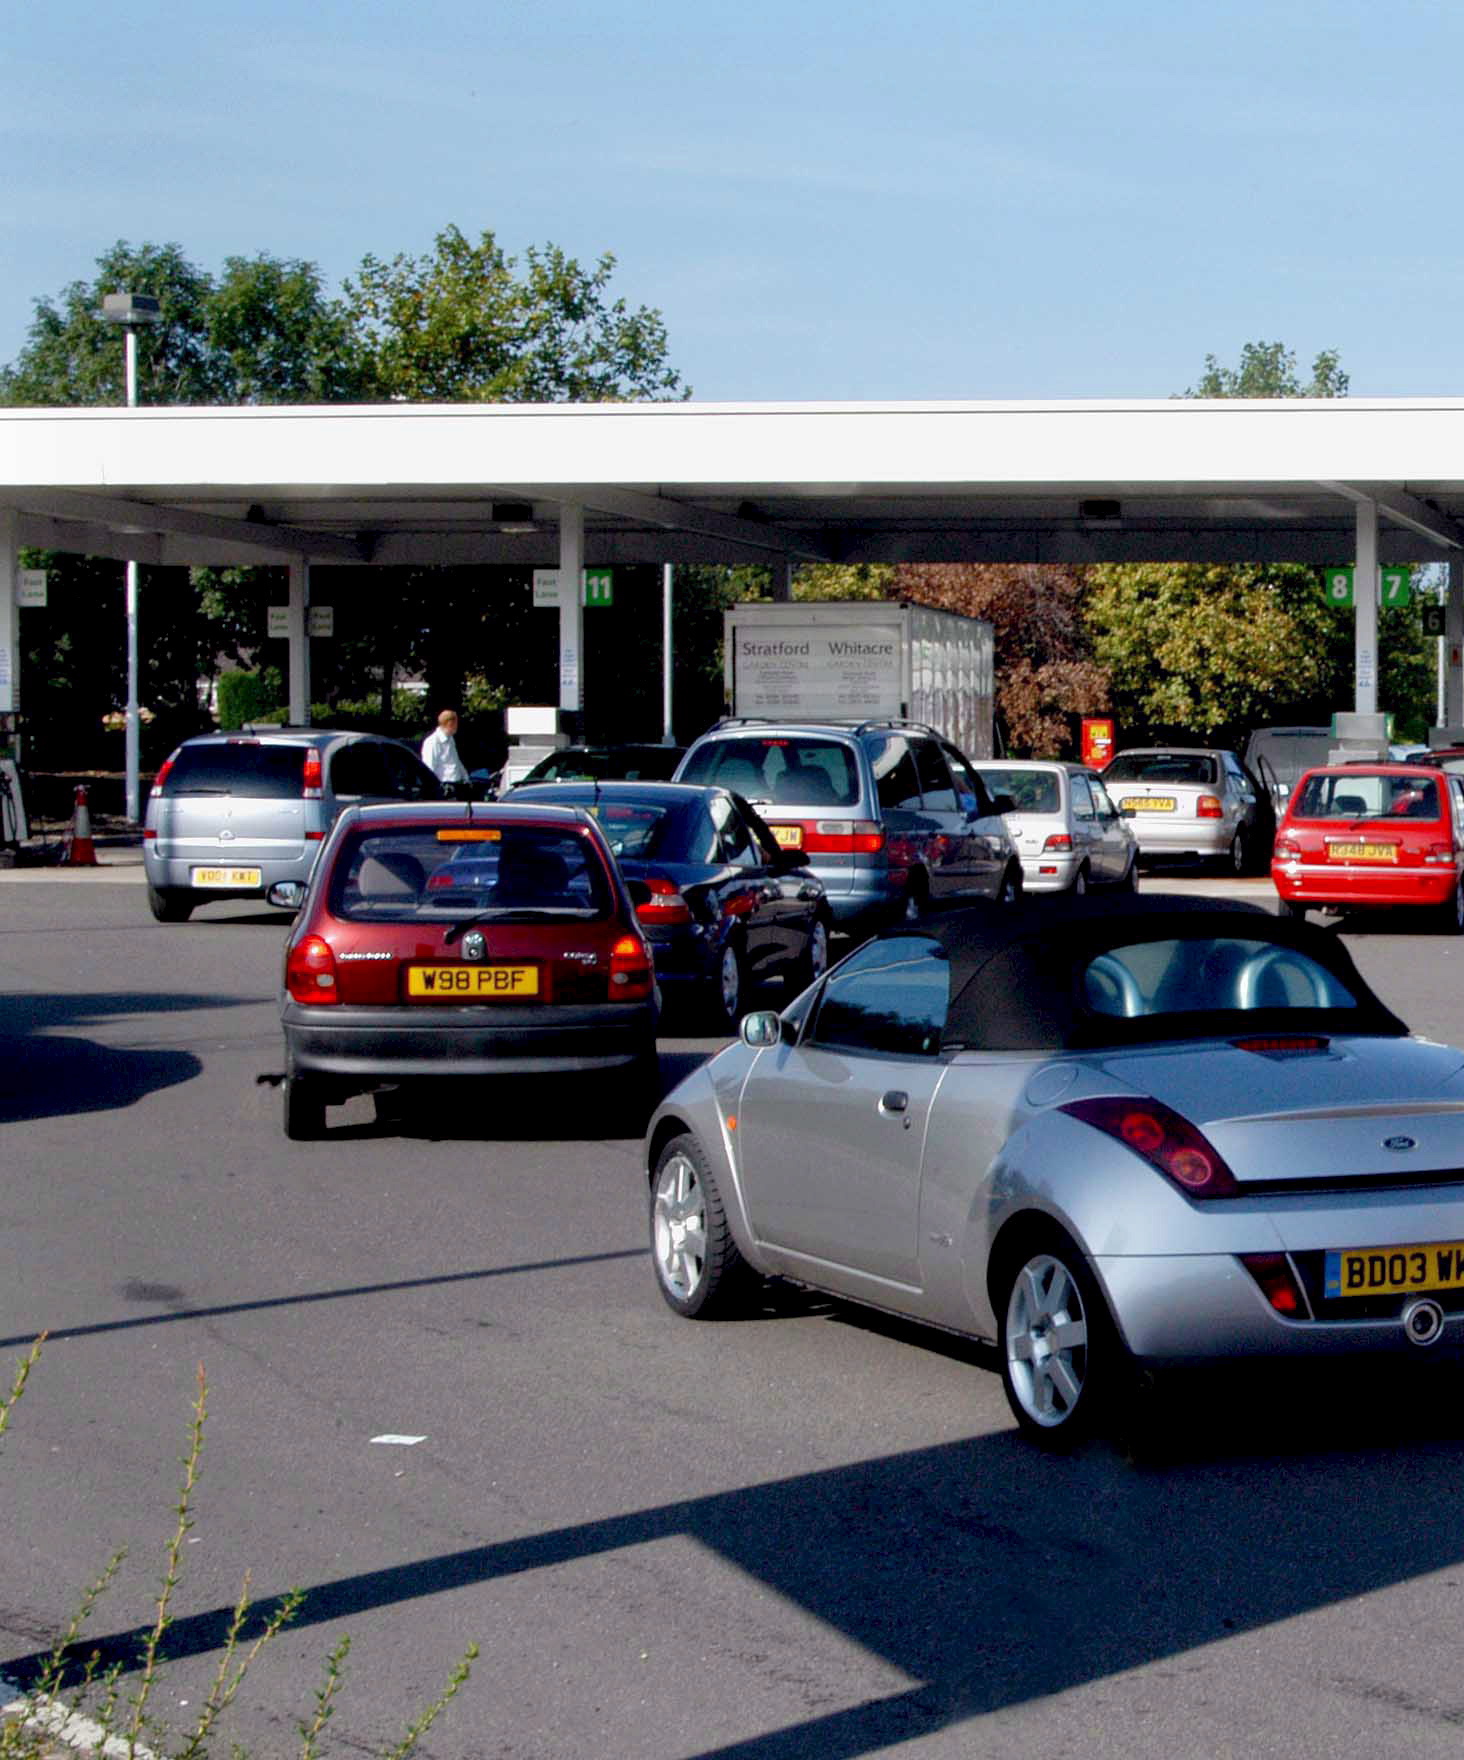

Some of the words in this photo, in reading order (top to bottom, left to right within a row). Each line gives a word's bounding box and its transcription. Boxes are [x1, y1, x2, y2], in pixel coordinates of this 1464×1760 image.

[588, 575, 610, 599] 11
[1332, 575, 1348, 599] 8
[1386, 575, 1401, 599] 7
[1428, 611, 1441, 631] 6
[743, 641, 810, 656] Stratford
[828, 641, 893, 656] Whitacre
[421, 969, 471, 991] W98
[477, 970, 526, 991] PBF
[1346, 1252, 1427, 1289] BD03
